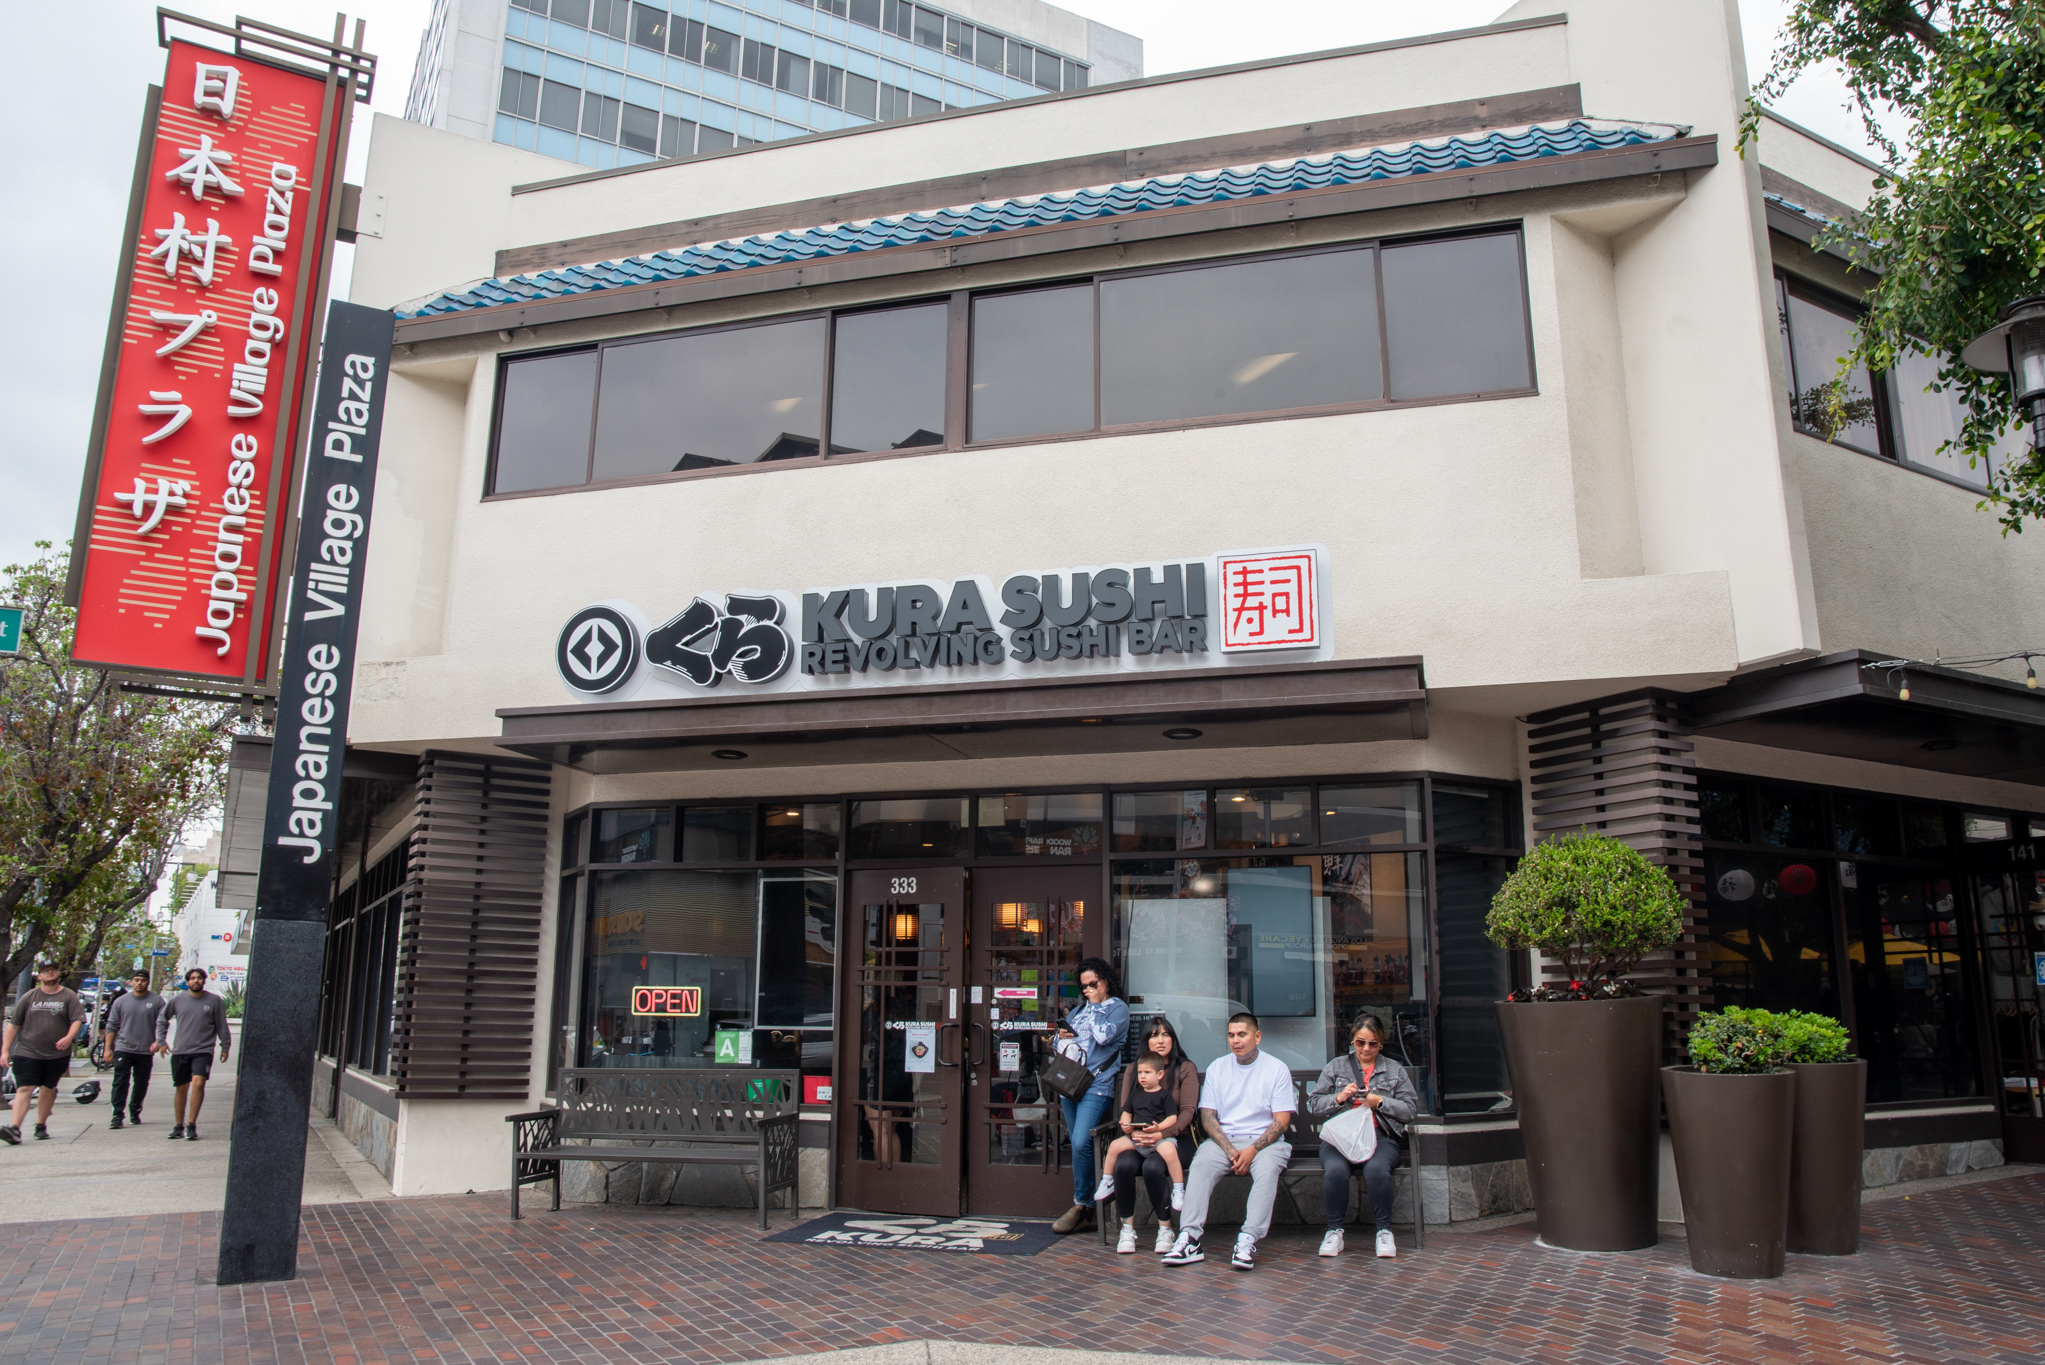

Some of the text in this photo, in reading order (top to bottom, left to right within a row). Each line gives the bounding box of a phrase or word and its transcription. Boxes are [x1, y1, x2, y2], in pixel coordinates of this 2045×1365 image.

[113, 61, 245, 536] 日本村プラザ
[195, 161, 298, 657] Japanese Village Plaza
[277, 352, 376, 864] Japanese Village Plaza
[801, 562, 1208, 643] KURA SUSHI
[802, 617, 1208, 676] REVOLVING SUSHI BAR
[2007, 844, 2036, 861] 141
[891, 877, 917, 894] 333
[635, 989, 697, 1013] OPEN
[719, 1038, 735, 1057] A
[805, 1238, 894, 1246] REVOLVING
[813, 1231, 984, 1247] KURA
